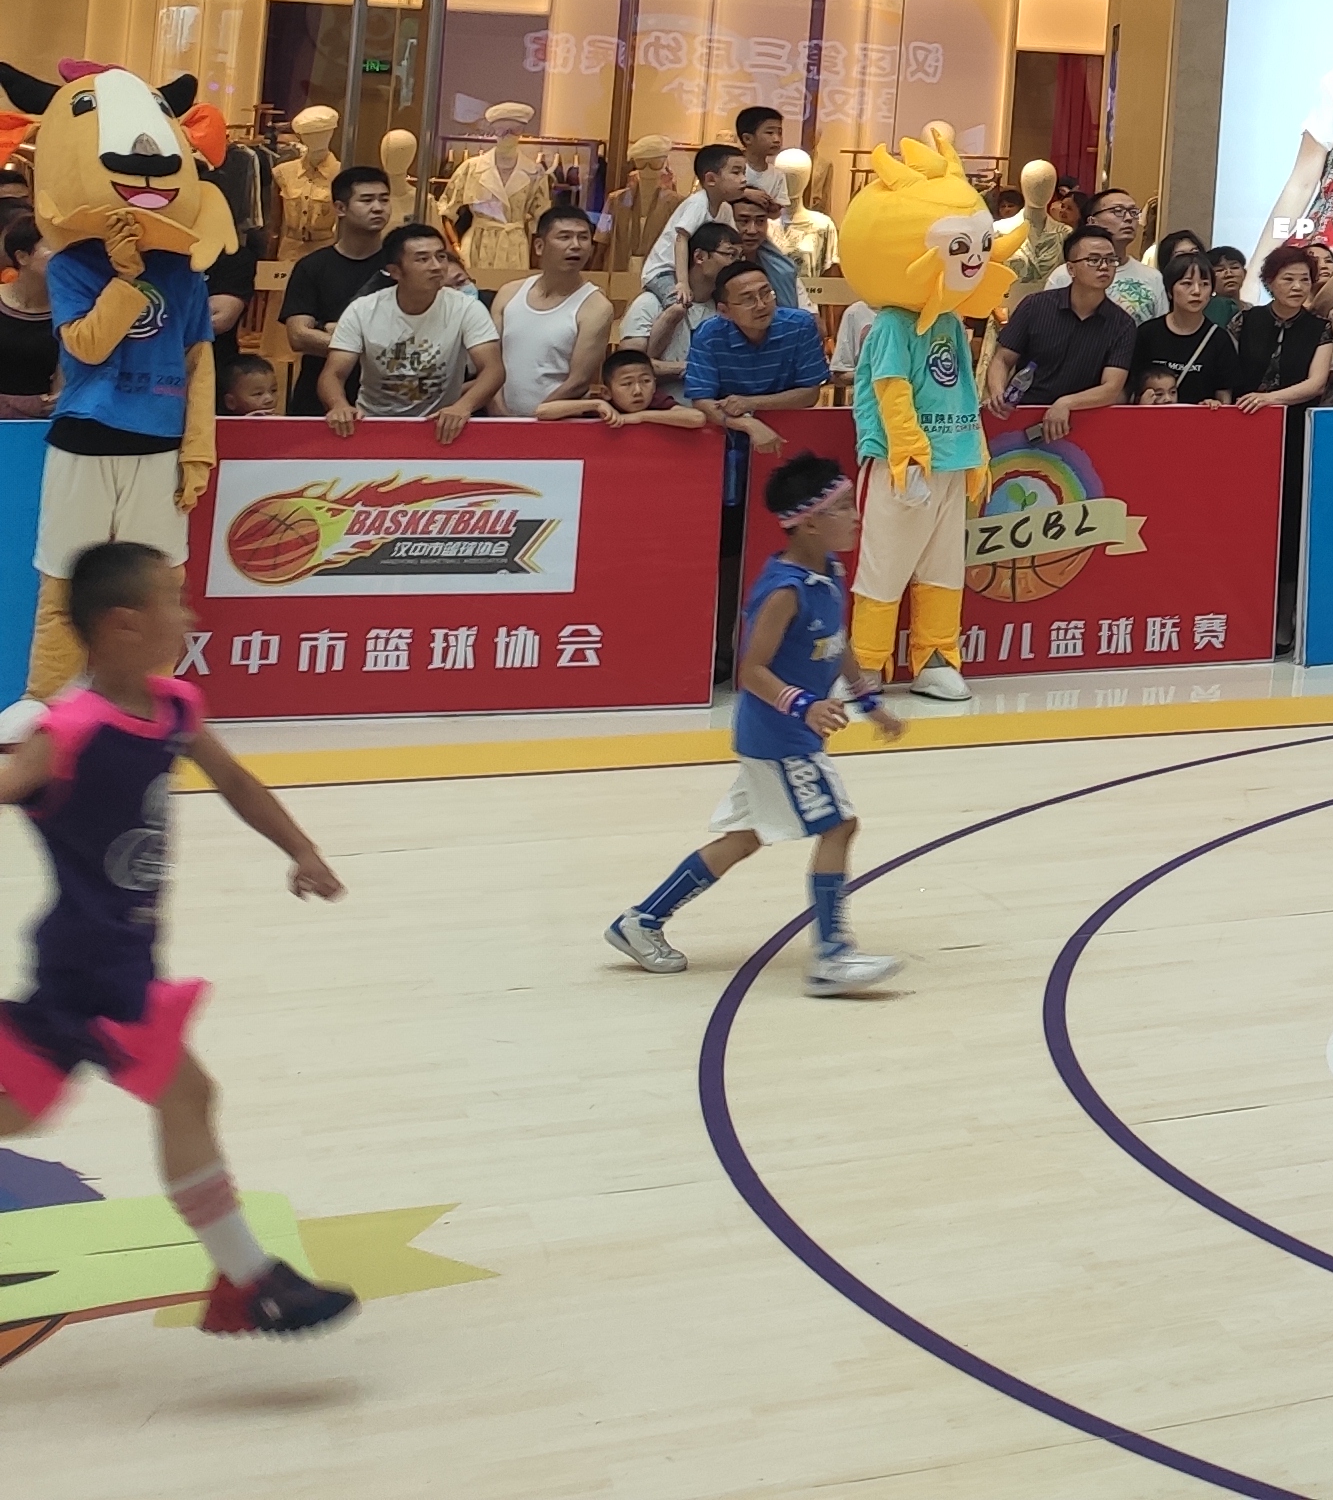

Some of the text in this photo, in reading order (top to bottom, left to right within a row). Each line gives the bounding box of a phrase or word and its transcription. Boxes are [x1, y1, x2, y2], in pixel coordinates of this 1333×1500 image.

[1272, 217, 1315, 240] EP
[344, 508, 519, 536] BASKETBALL
[965, 503, 1098, 557] ZCBL
